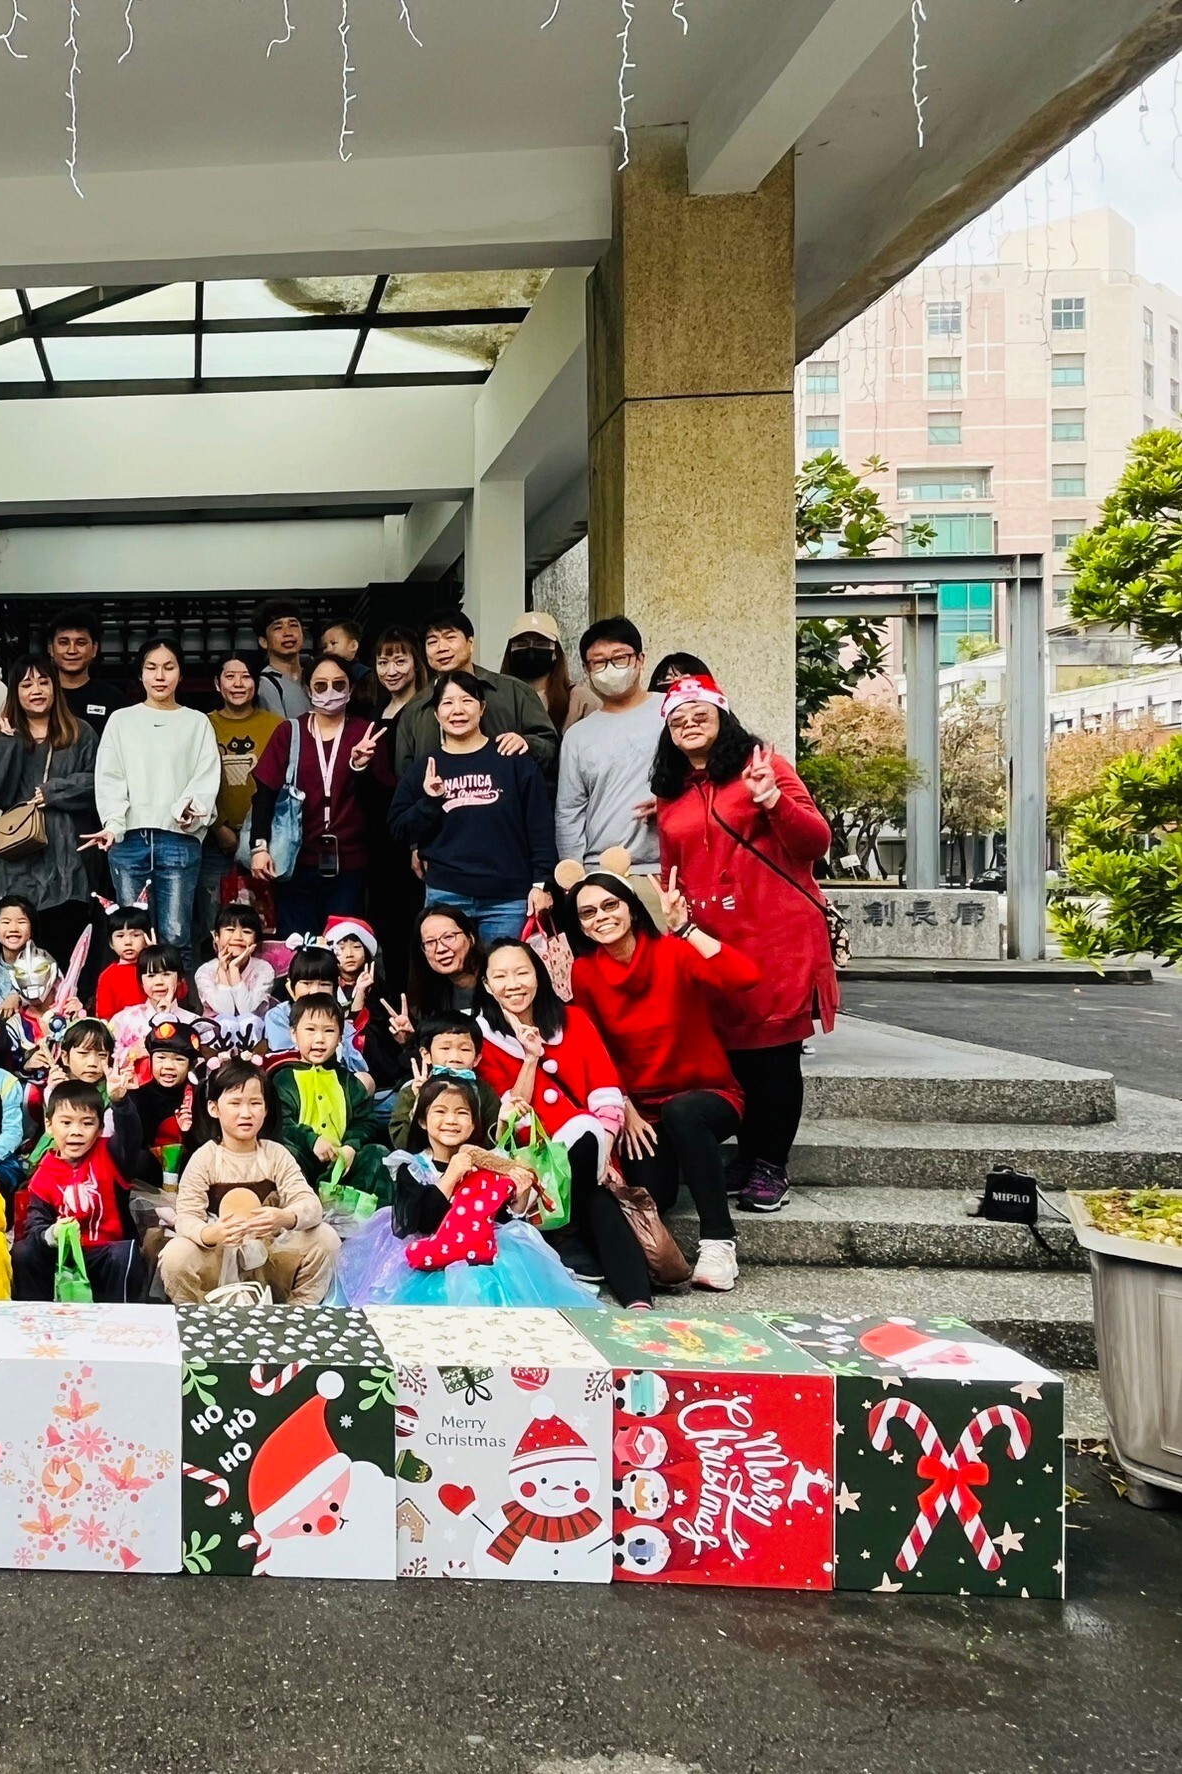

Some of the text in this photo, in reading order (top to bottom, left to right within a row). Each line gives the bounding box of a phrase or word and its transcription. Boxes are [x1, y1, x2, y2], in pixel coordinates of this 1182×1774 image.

[444, 774, 492, 790] NAUTICA
[992, 1191, 1030, 1204] MIPRO
[189, 1403, 258, 1440] HO HO
[440, 1414, 488, 1434] Merry
[424, 1431, 507, 1449] Christmas
[217, 1440, 253, 1473] HO
[673, 1395, 752, 1560] Christmas
[732, 1430, 790, 1528] Merry
